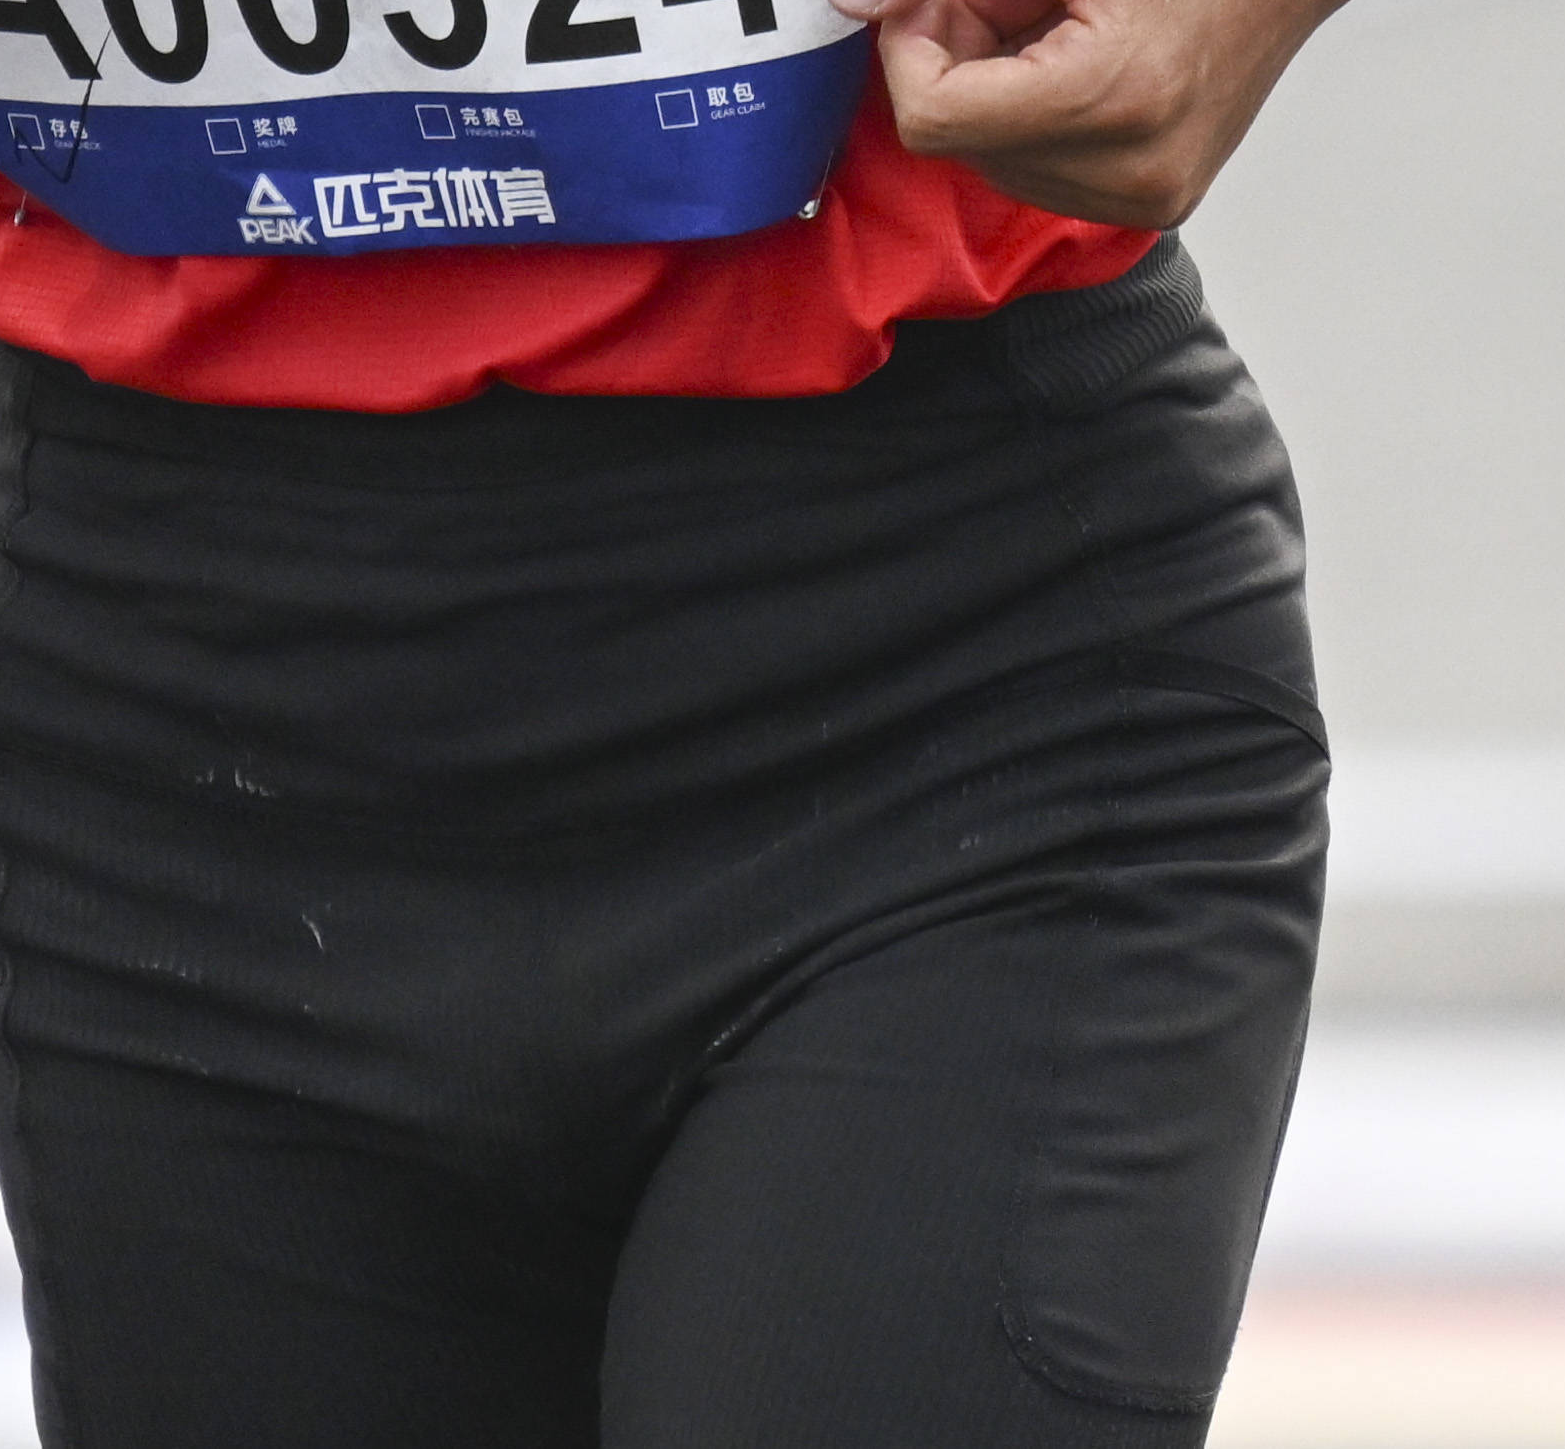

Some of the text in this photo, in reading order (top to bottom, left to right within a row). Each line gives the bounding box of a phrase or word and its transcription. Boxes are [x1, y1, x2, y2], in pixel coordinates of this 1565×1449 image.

[706, 82, 755, 107] 取包
[460, 106, 524, 127] 完赛包
[710, 101, 766, 120] GEAR CLAIM
[48, 118, 88, 139] 存包
[252, 115, 298, 138] 奖牌
[313, 167, 556, 238] 匹克体育
[237, 216, 318, 244] PEAK
